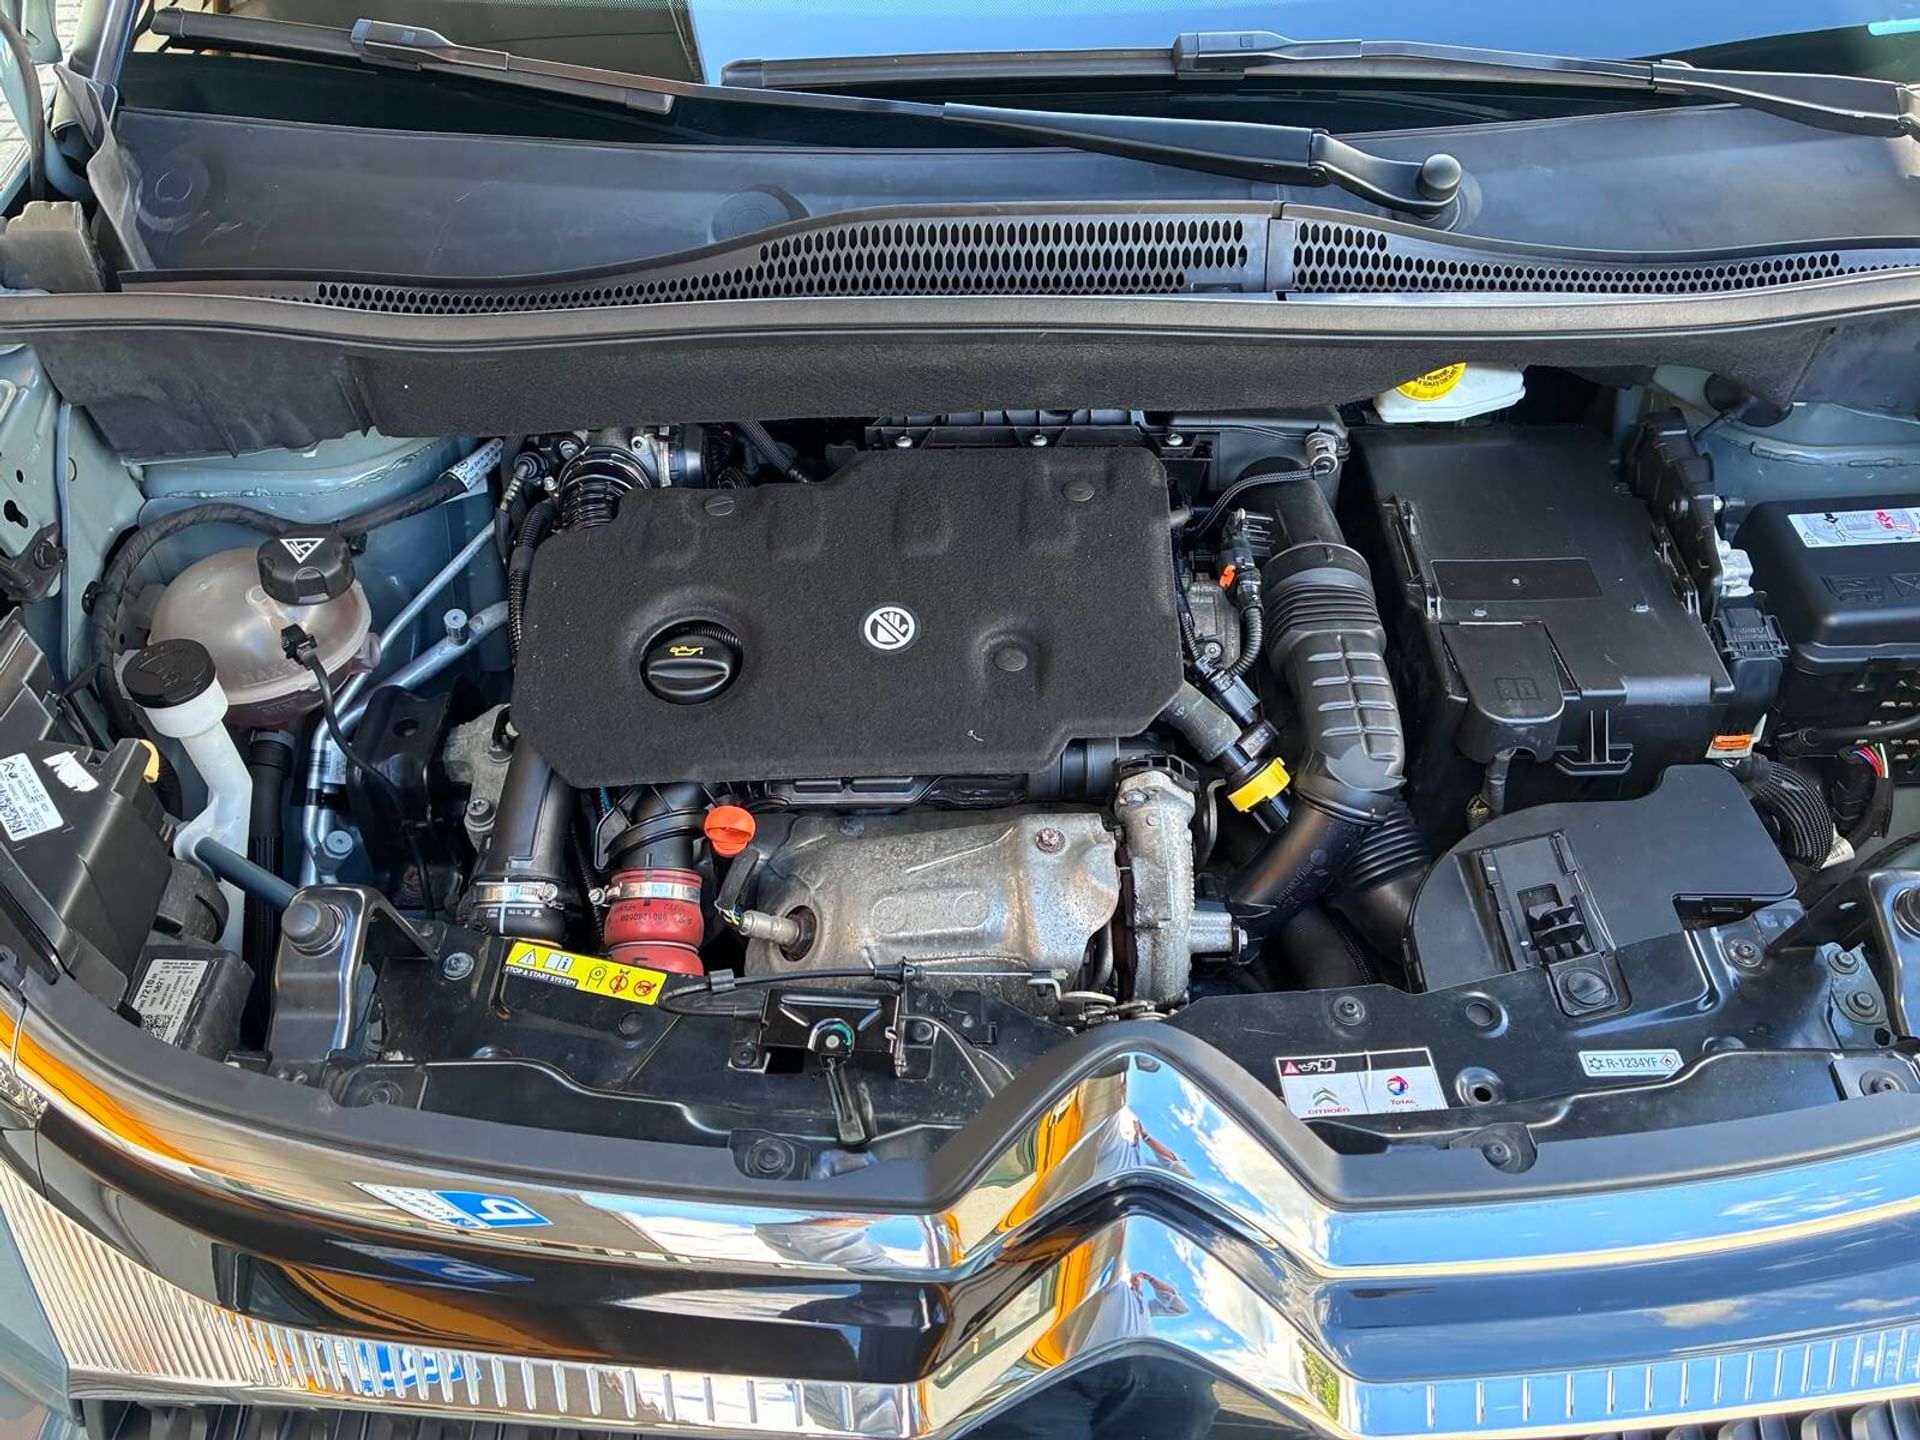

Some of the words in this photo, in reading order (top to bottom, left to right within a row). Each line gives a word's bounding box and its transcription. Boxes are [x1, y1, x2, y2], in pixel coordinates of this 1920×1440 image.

[505, 966, 523, 975] STOP
[529, 970, 551, 981] START
[551, 976, 577, 988] SYSTEM
[1606, 1057, 1659, 1069] R-1234YF
